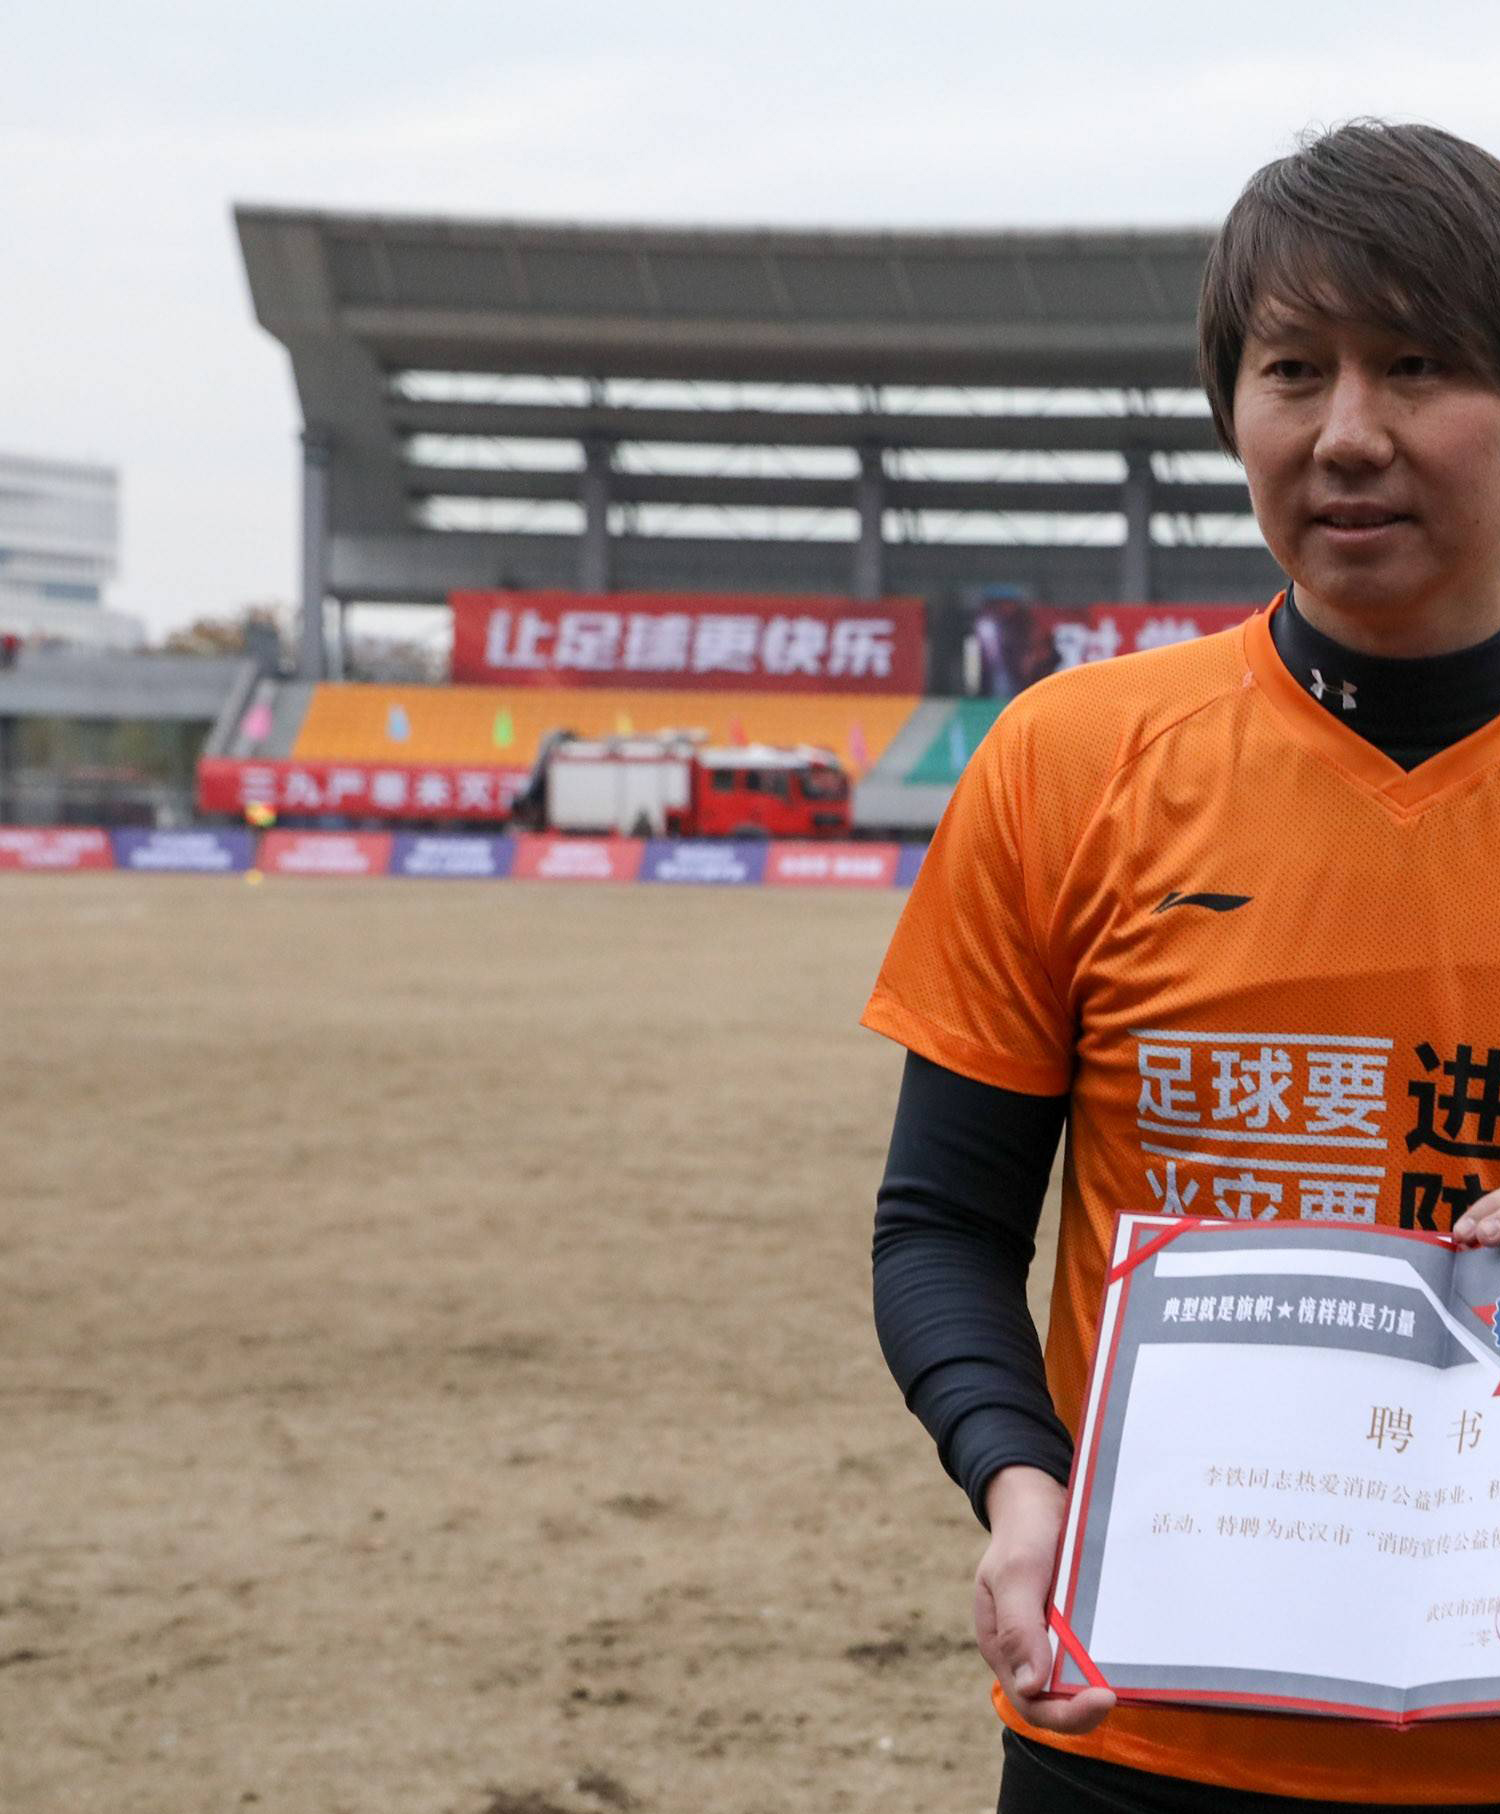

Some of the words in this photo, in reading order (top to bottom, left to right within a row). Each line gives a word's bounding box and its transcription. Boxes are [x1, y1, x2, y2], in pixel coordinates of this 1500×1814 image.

[485, 608, 896, 678] 让足球更快乐
[1136, 1042, 1389, 1137] 足球要
[1162, 1294, 1275, 1324] 典型就是旗帜
[1296, 1296, 1417, 1339] 榜样就是力量
[1365, 1404, 1485, 1455] 聘书
